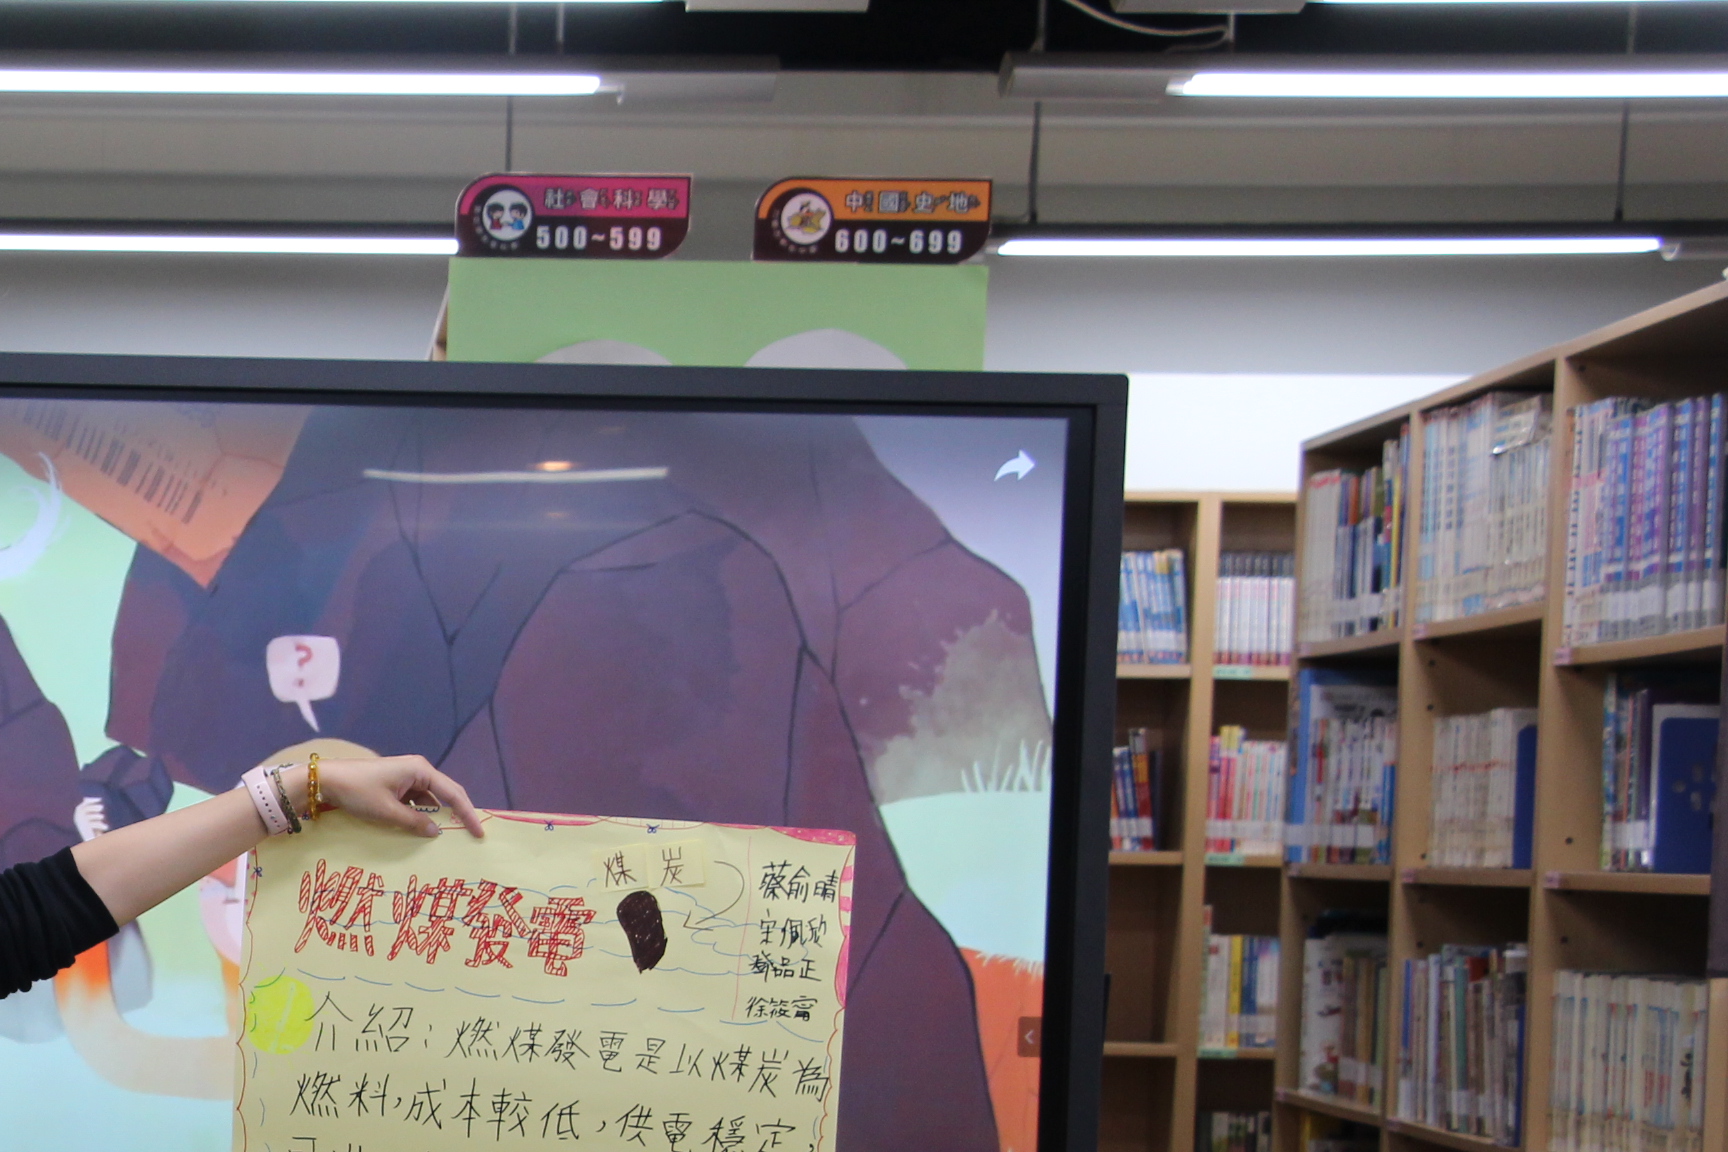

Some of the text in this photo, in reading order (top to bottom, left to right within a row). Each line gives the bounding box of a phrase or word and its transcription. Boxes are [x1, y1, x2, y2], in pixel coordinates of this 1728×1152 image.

[535, 225, 663, 250] 500~599
[834, 228, 963, 254] 600~699
[603, 846, 687, 889] 煤炭
[293, 858, 598, 979] 燃煤發電
